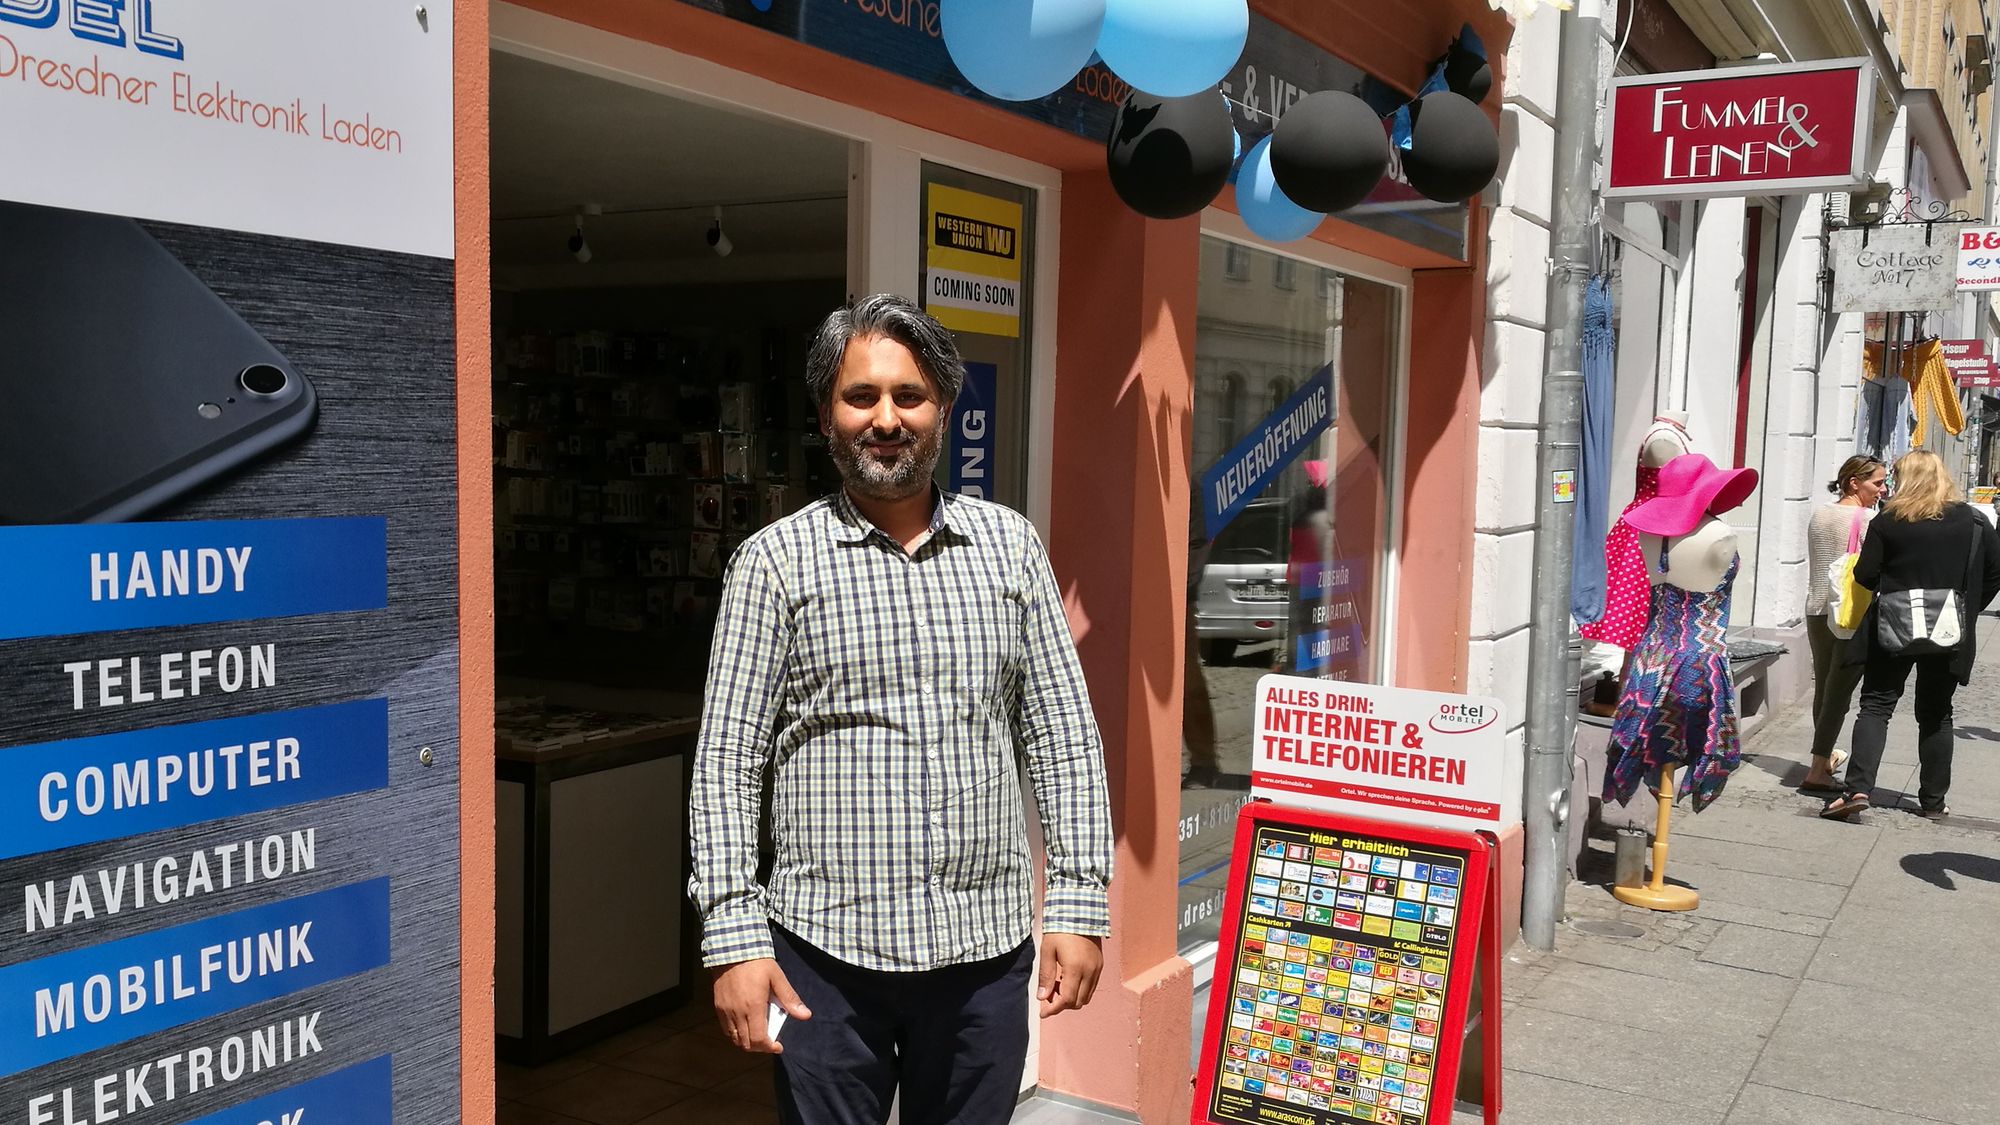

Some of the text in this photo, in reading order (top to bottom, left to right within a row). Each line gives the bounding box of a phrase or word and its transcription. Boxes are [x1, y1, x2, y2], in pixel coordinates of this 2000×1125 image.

[173, 72, 310, 136] Elektronik
[322, 103, 402, 153] Laden
[1777, 103, 1820, 150] &
[1663, 137, 1793, 179] LEINEN
[937, 216, 983, 236] WESTERN
[952, 231, 983, 249] UNION
[987, 226, 1011, 255] WU
[1856, 251, 1943, 272] Cottage
[934, 276, 1015, 307] COMING SOON
[1940, 344, 1970, 354] riseur
[1215, 386, 1327, 515] NEUERÖFFNUNG
[90, 546, 252, 601] HANDY
[1317, 565, 1350, 589] ZUBEHÖR
[1312, 601, 1352, 624] REPARATUR
[1311, 635, 1350, 660] HARDWARE
[64, 643, 276, 710] TELEFON
[1266, 687, 1374, 714] ALLES DRIN:
[1440, 704, 1484, 718] ortel
[1264, 706, 1424, 750] INTERNET &
[1440, 715, 1483, 725] MOBILE
[1262, 734, 1467, 786] TELEFONIEREN
[38, 736, 301, 822] COMPUTER
[1438, 801, 1464, 811] Powered
[1309, 832, 1409, 857] Hier erhältlich
[24, 827, 316, 933] NAVIGATION
[1248, 915, 1284, 927] Cashkarten
[1401, 942, 1448, 957] Callingkarten
[35, 921, 314, 1038] MOBILFUNK
[29, 1012, 323, 1125] ELEKTRONIK
[1259, 1107, 1316, 1125] www.arascom.de
